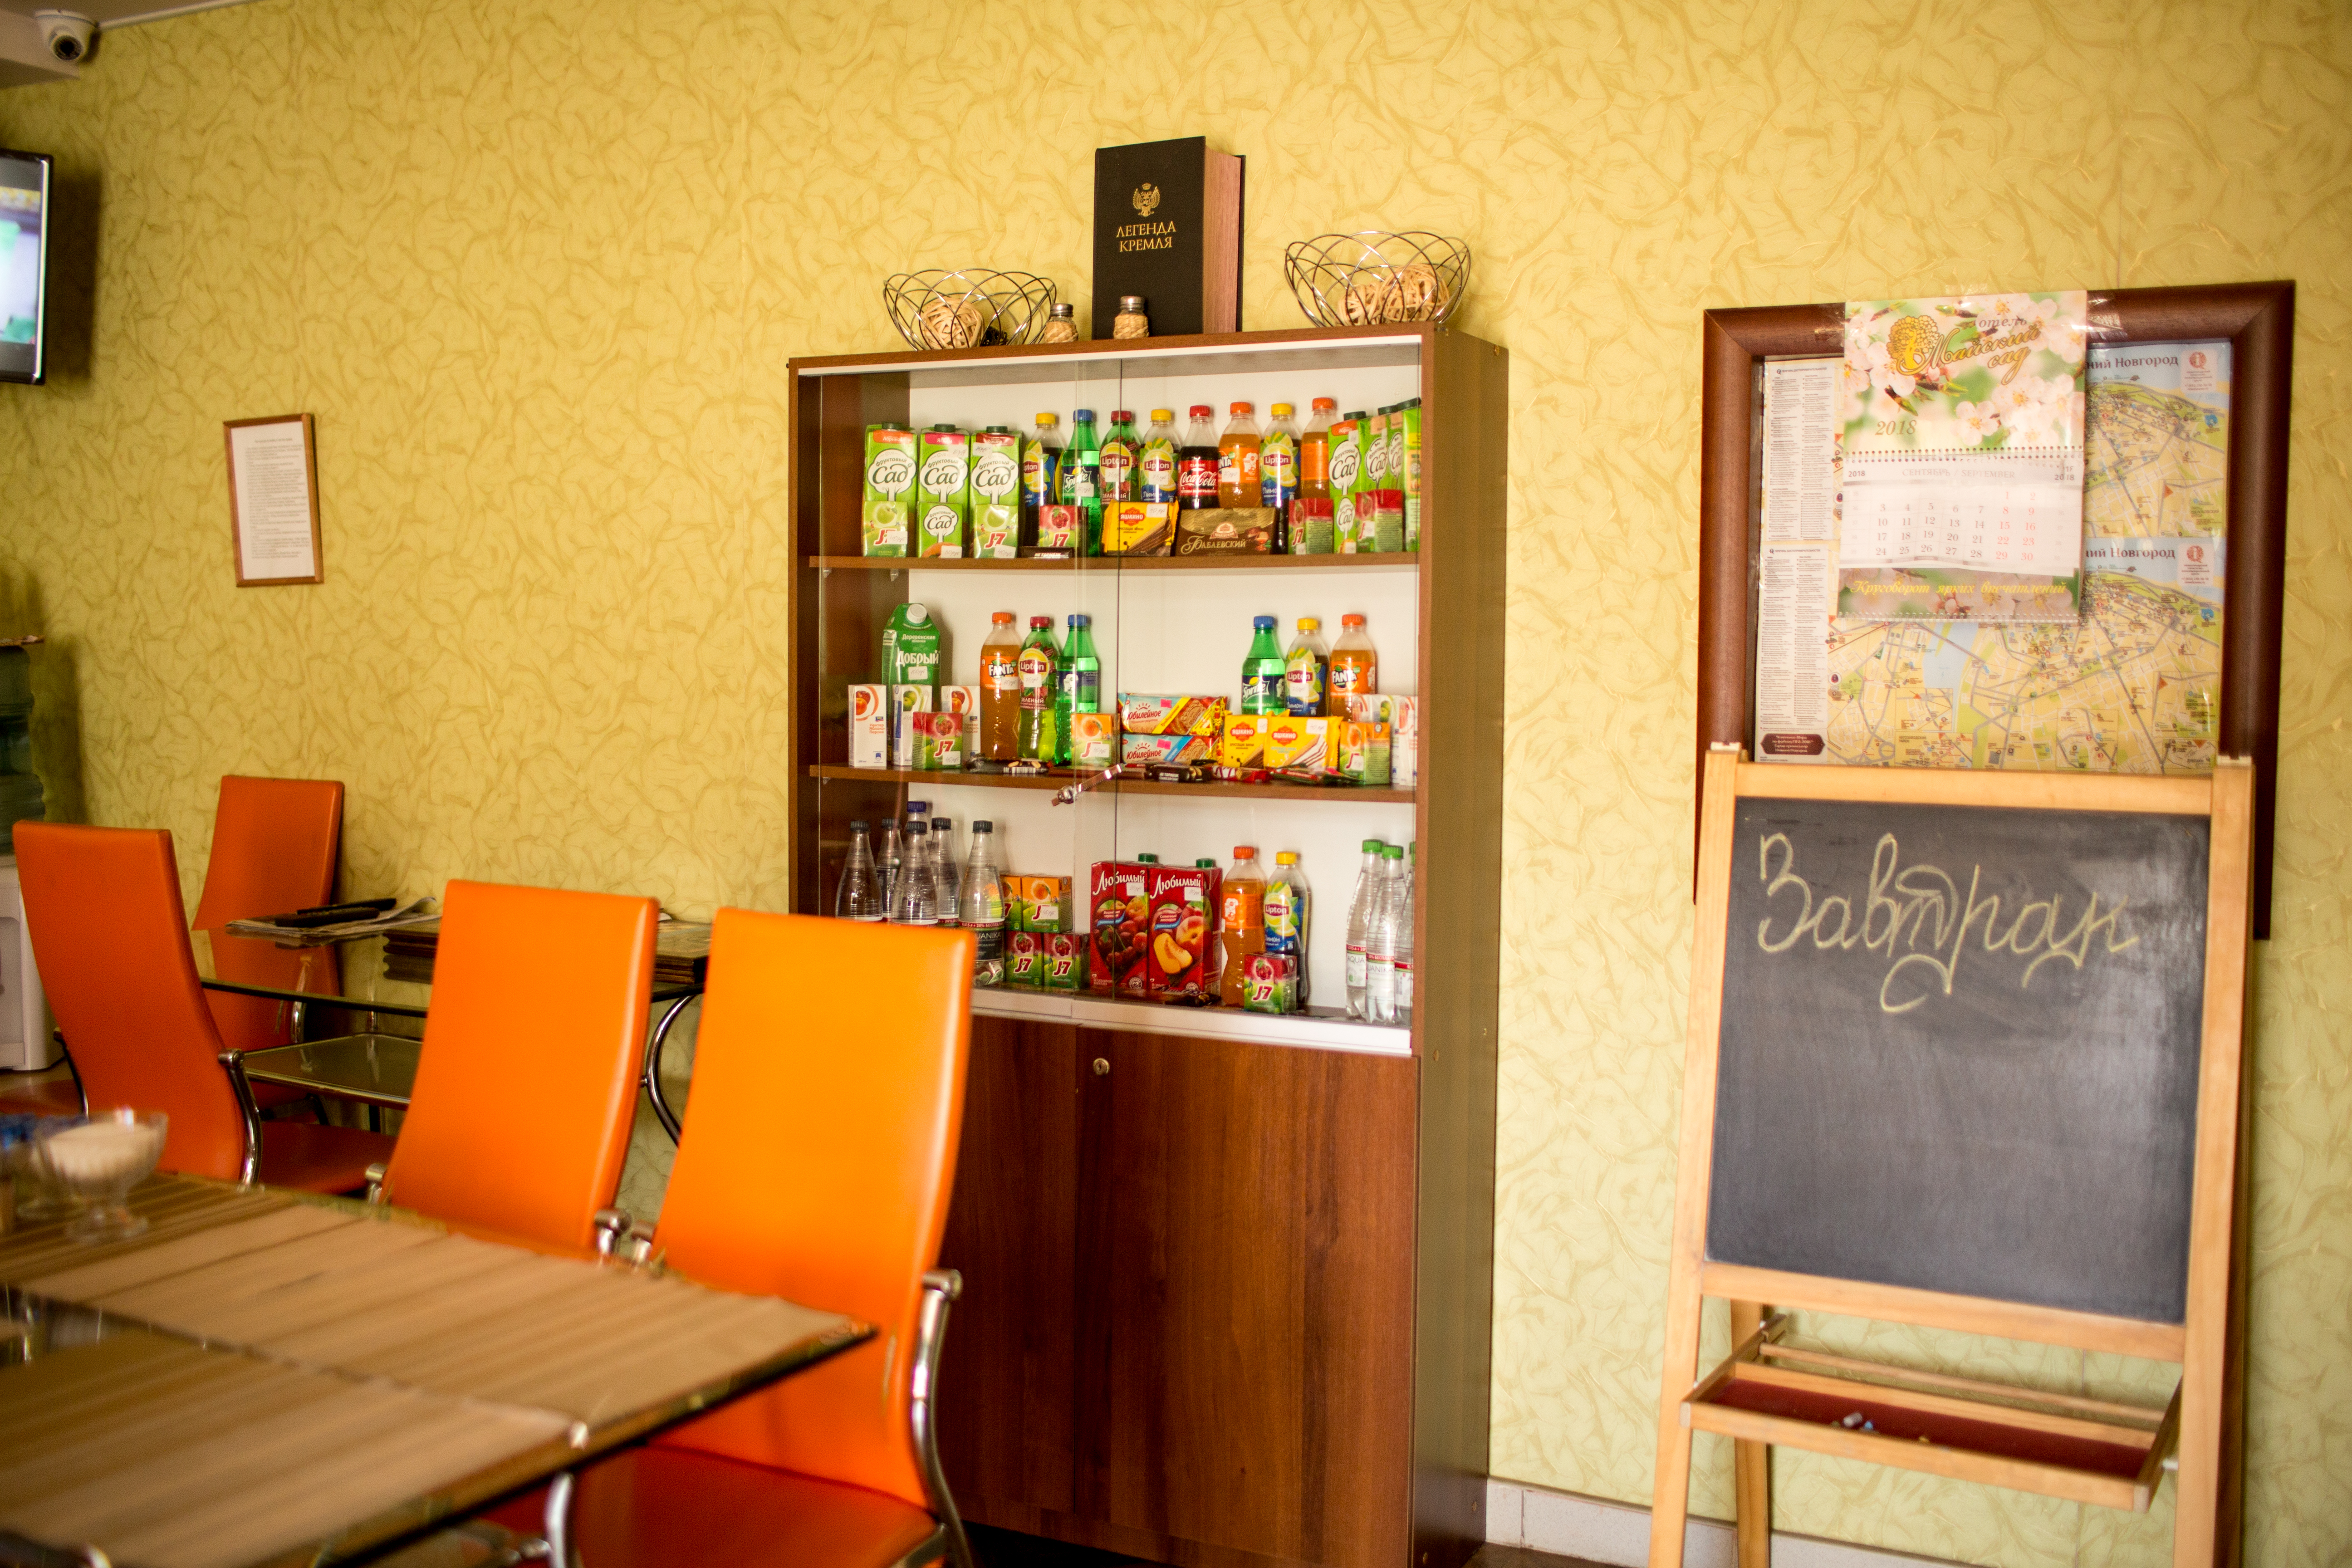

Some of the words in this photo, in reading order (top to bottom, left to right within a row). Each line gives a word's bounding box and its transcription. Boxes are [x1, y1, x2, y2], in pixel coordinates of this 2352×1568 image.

[1116, 221, 1176, 238] ЛЕГЕНДА
[1119, 236, 1172, 252] КРЕМЛЯ
[1979, 318, 2027, 328] отель
[1903, 323, 2041, 373] Майский
[1988, 347, 2031, 385] сад
[2087, 359, 2111, 369] ний
[2115, 356, 2178, 368] Новгород
[1875, 420, 1917, 436] 2018
[876, 457, 907, 466] фруктовый
[928, 458, 958, 468] фруктовый
[979, 461, 1009, 470] фруктовый
[1218, 456, 1232, 469] NTA
[1332, 455, 1356, 480] Сад
[872, 464, 908, 484] Сад
[924, 465, 959, 485] Сад
[976, 466, 1011, 487] Сад
[1902, 468, 1950, 476] СЕНТЯБРЬ
[1961, 469, 2015, 478] SEPTEMBER
[1905, 504, 1910, 512] 4
[1953, 504, 1958, 513] 6
[2029, 507, 2034, 515] 9
[927, 515, 952, 529] Сад
[1878, 518, 1887, 526] 10
[1902, 518, 1911, 526] 11
[1950, 519, 1960, 527] 13
[1975, 520, 1984, 529] 14
[2000, 521, 2010, 529] 15
[2025, 522, 2035, 531] 16
[985, 533, 1006, 548] J7
[1052, 533, 1069, 547] J7
[1901, 532, 1910, 540] 18
[1924, 530, 1933, 539] 19
[1947, 533, 1958, 541] 20
[1973, 535, 1982, 544] 21
[1997, 536, 2009, 544] 22
[2023, 537, 2034, 546] 23
[1899, 546, 1909, 554] 25
[1921, 544, 1932, 553] 26
[1945, 547, 1956, 555] 27
[1971, 549, 1982, 558] 28
[1996, 551, 2008, 559] 29
[2021, 552, 2033, 561] 30
[2111, 548, 2176, 559] Новгород
[1851, 581, 1929, 594] Круговорот
[1936, 583, 1975, 594] ярких
[1981, 581, 2067, 594] впечатлений
[988, 663, 1014, 676] FANTA
[1021, 662, 1044, 671] Lipton
[1332, 670, 1357, 681] FANTA
[1243, 682, 1266, 696] Sprite
[1127, 710, 1162, 720] Юбилейное
[935, 740, 954, 756] J7
[1126, 749, 1161, 760] Юбилейное
[1093, 870, 1145, 895] Любимый
[1150, 874, 1201, 899] Любимый
[1266, 905, 1287, 914] Lipton
[1758, 832, 2139, 1013] Завтрак
[1015, 958, 1032, 972] J7
[1347, 955, 1365, 965] AQUA
[1054, 961, 1071, 975] J7
[1253, 985, 1273, 1000] J7
